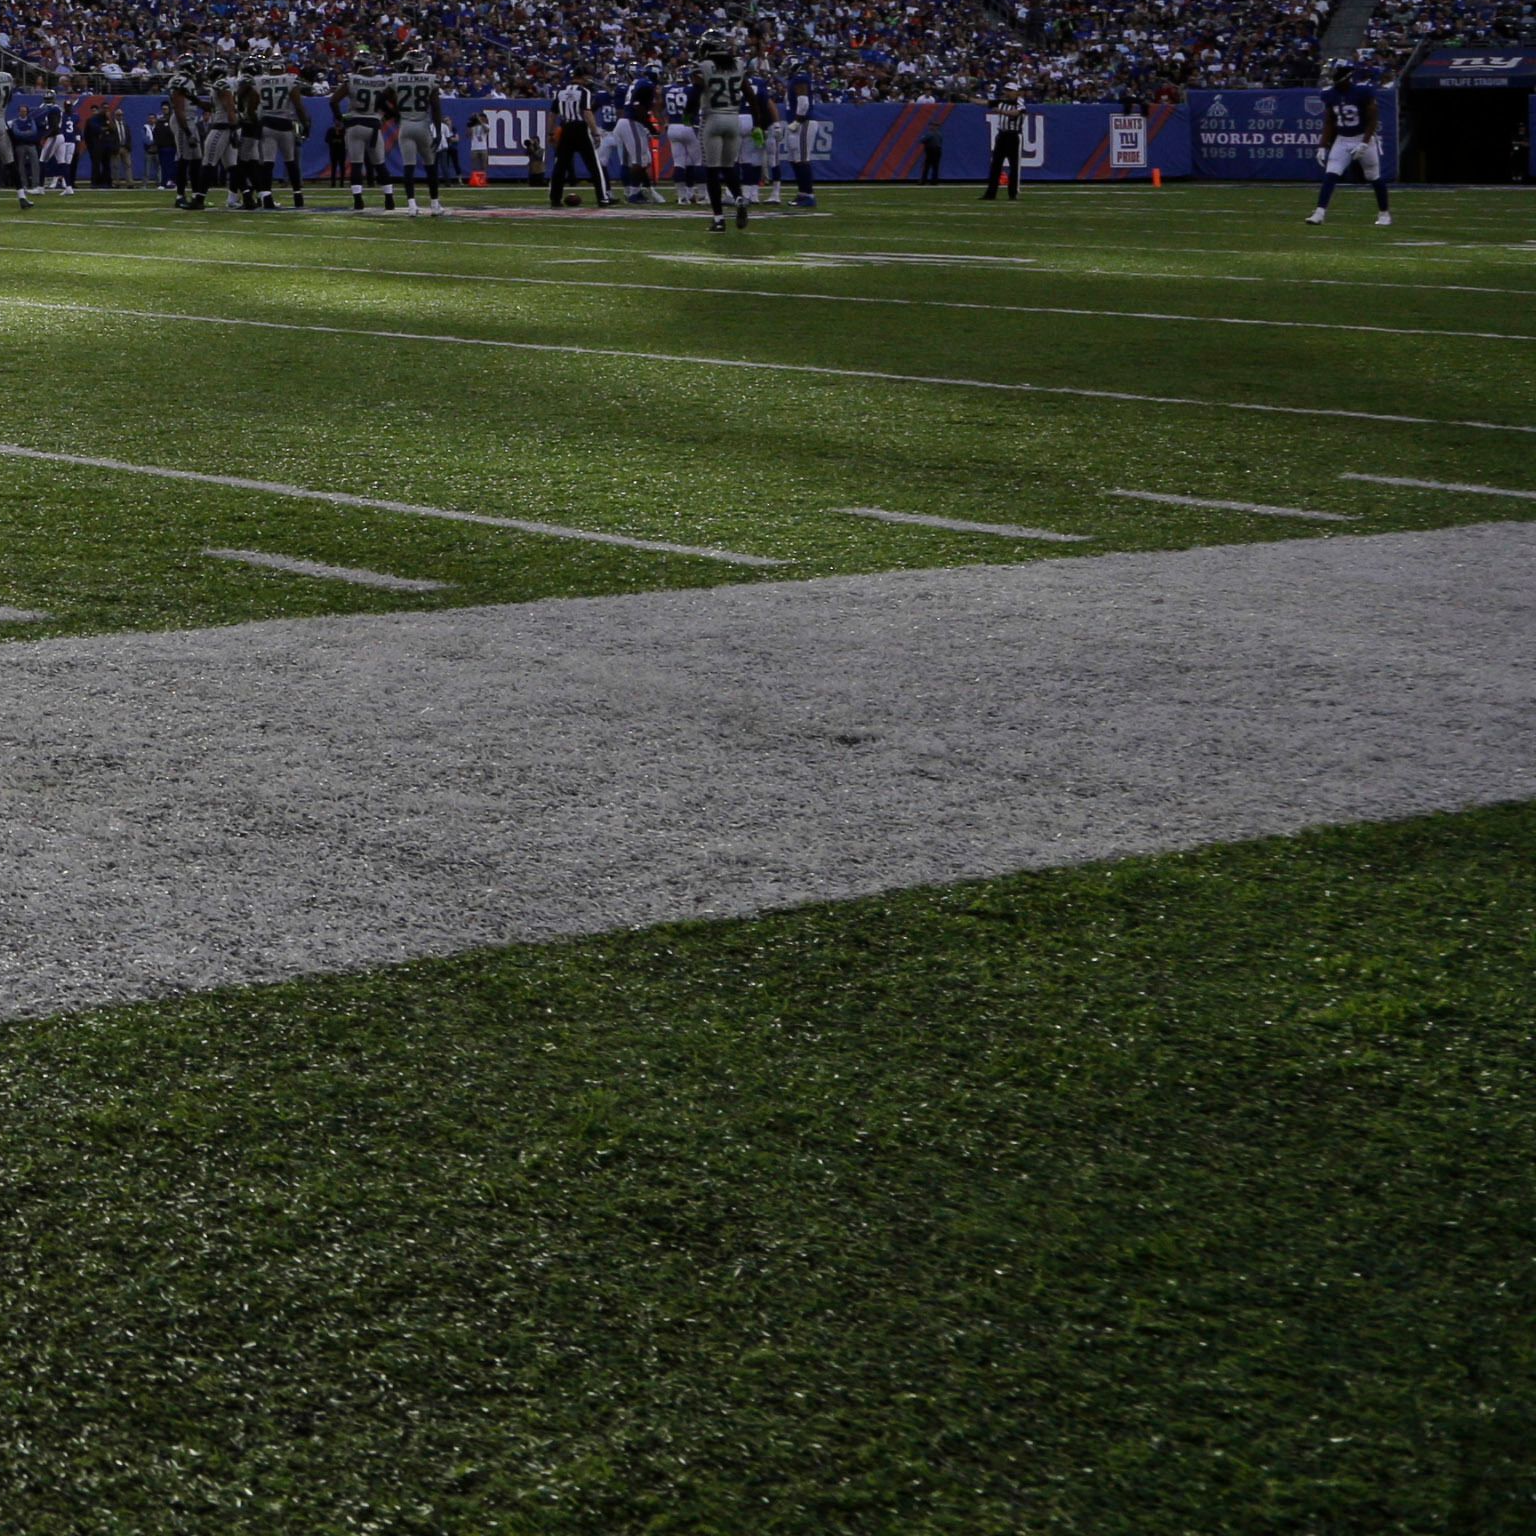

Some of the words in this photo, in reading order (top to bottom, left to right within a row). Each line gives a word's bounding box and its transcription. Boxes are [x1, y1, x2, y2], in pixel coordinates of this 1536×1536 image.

[1439, 77, 1472, 86] METLIFE
[1473, 78, 1509, 87] STADIUM
[261, 87, 289, 110] 97
[397, 85, 430, 112] 28
[665, 93, 687, 115] 69
[1332, 105, 1360, 127] 13
[1114, 118, 1142, 130] GIANTS
[1200, 119, 1236, 130] 2011
[1248, 119, 1285, 130] 2007
[1296, 119, 1325, 130] 199
[483, 109, 547, 165] ny
[1119, 132, 1138, 149] ny
[1200, 133, 1265, 145] WORLD
[1117, 151, 1140, 163] PRIDE
[1200, 147, 1236, 159] 1956
[1248, 147, 1285, 159] 1938
